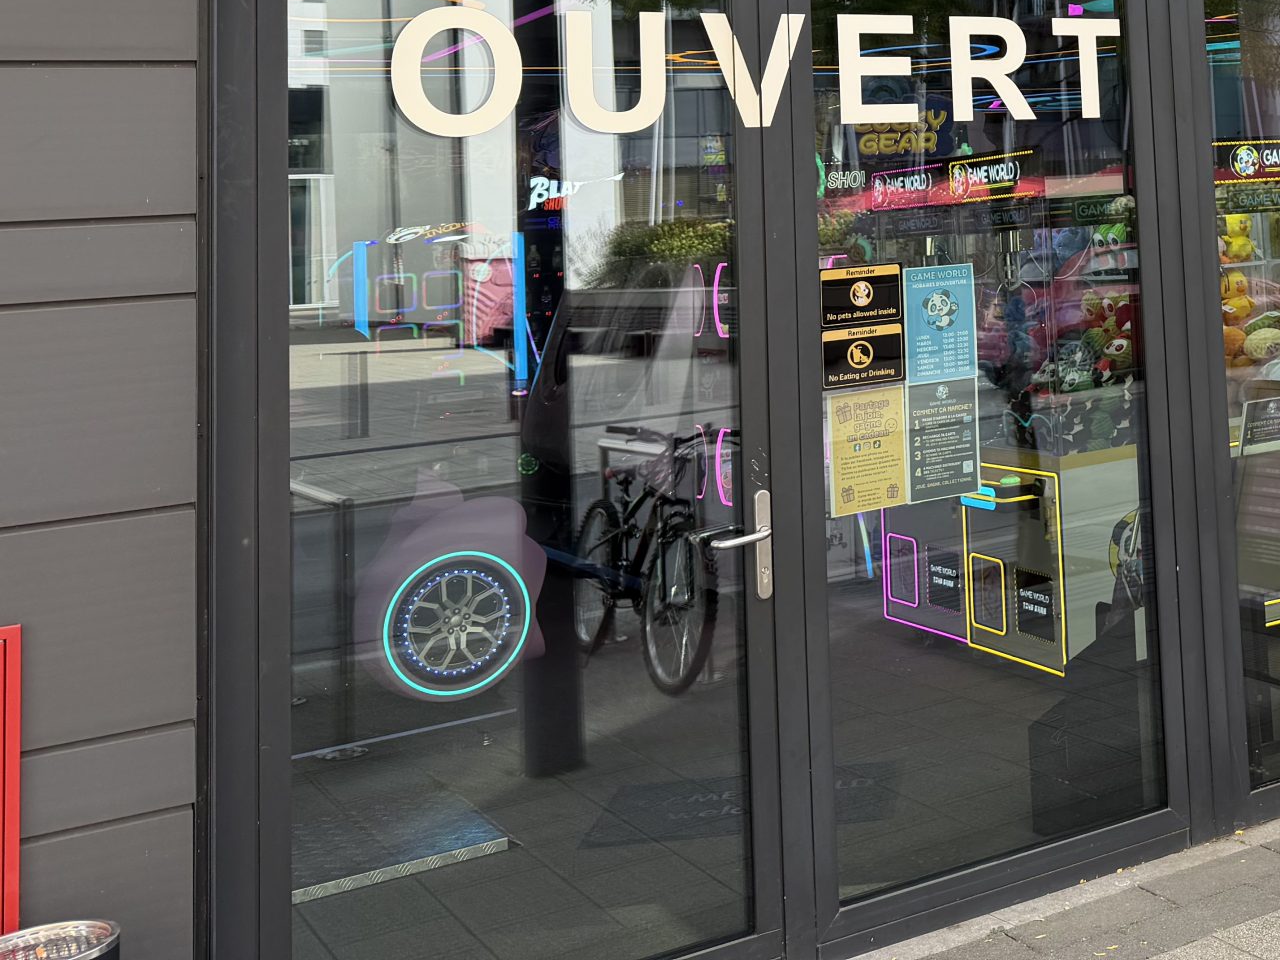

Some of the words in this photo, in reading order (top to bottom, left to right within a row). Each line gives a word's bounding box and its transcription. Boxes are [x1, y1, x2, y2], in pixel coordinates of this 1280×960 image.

[390, 5, 1121, 138] OUVERT
[859, 131, 938, 155] GEAR
[967, 166, 989, 184] GAME
[990, 162, 1015, 183] WORLD
[886, 177, 904, 191] GAME
[905, 173, 926, 190] WORLD
[1239, 194, 1271, 206] GAME
[911, 271, 935, 281] GAME
[937, 269, 968, 279] WORLD
[838, 312, 852, 320] pets
[853, 309, 877, 318] allowed
[878, 307, 896, 315] inside
[848, 328, 877, 336] Reminder
[840, 372, 859, 381] Eating
[869, 368, 895, 376] Drinking
[853, 400, 890, 411] Partage
[854, 420, 882, 433] gagne
[914, 420, 920, 429] 1
[914, 437, 920, 446] 2
[914, 451, 921, 460] 3
[915, 468, 921, 476] 4
[1020, 588, 1033, 599] GAME
[1033, 593, 1050, 604] WORLD
